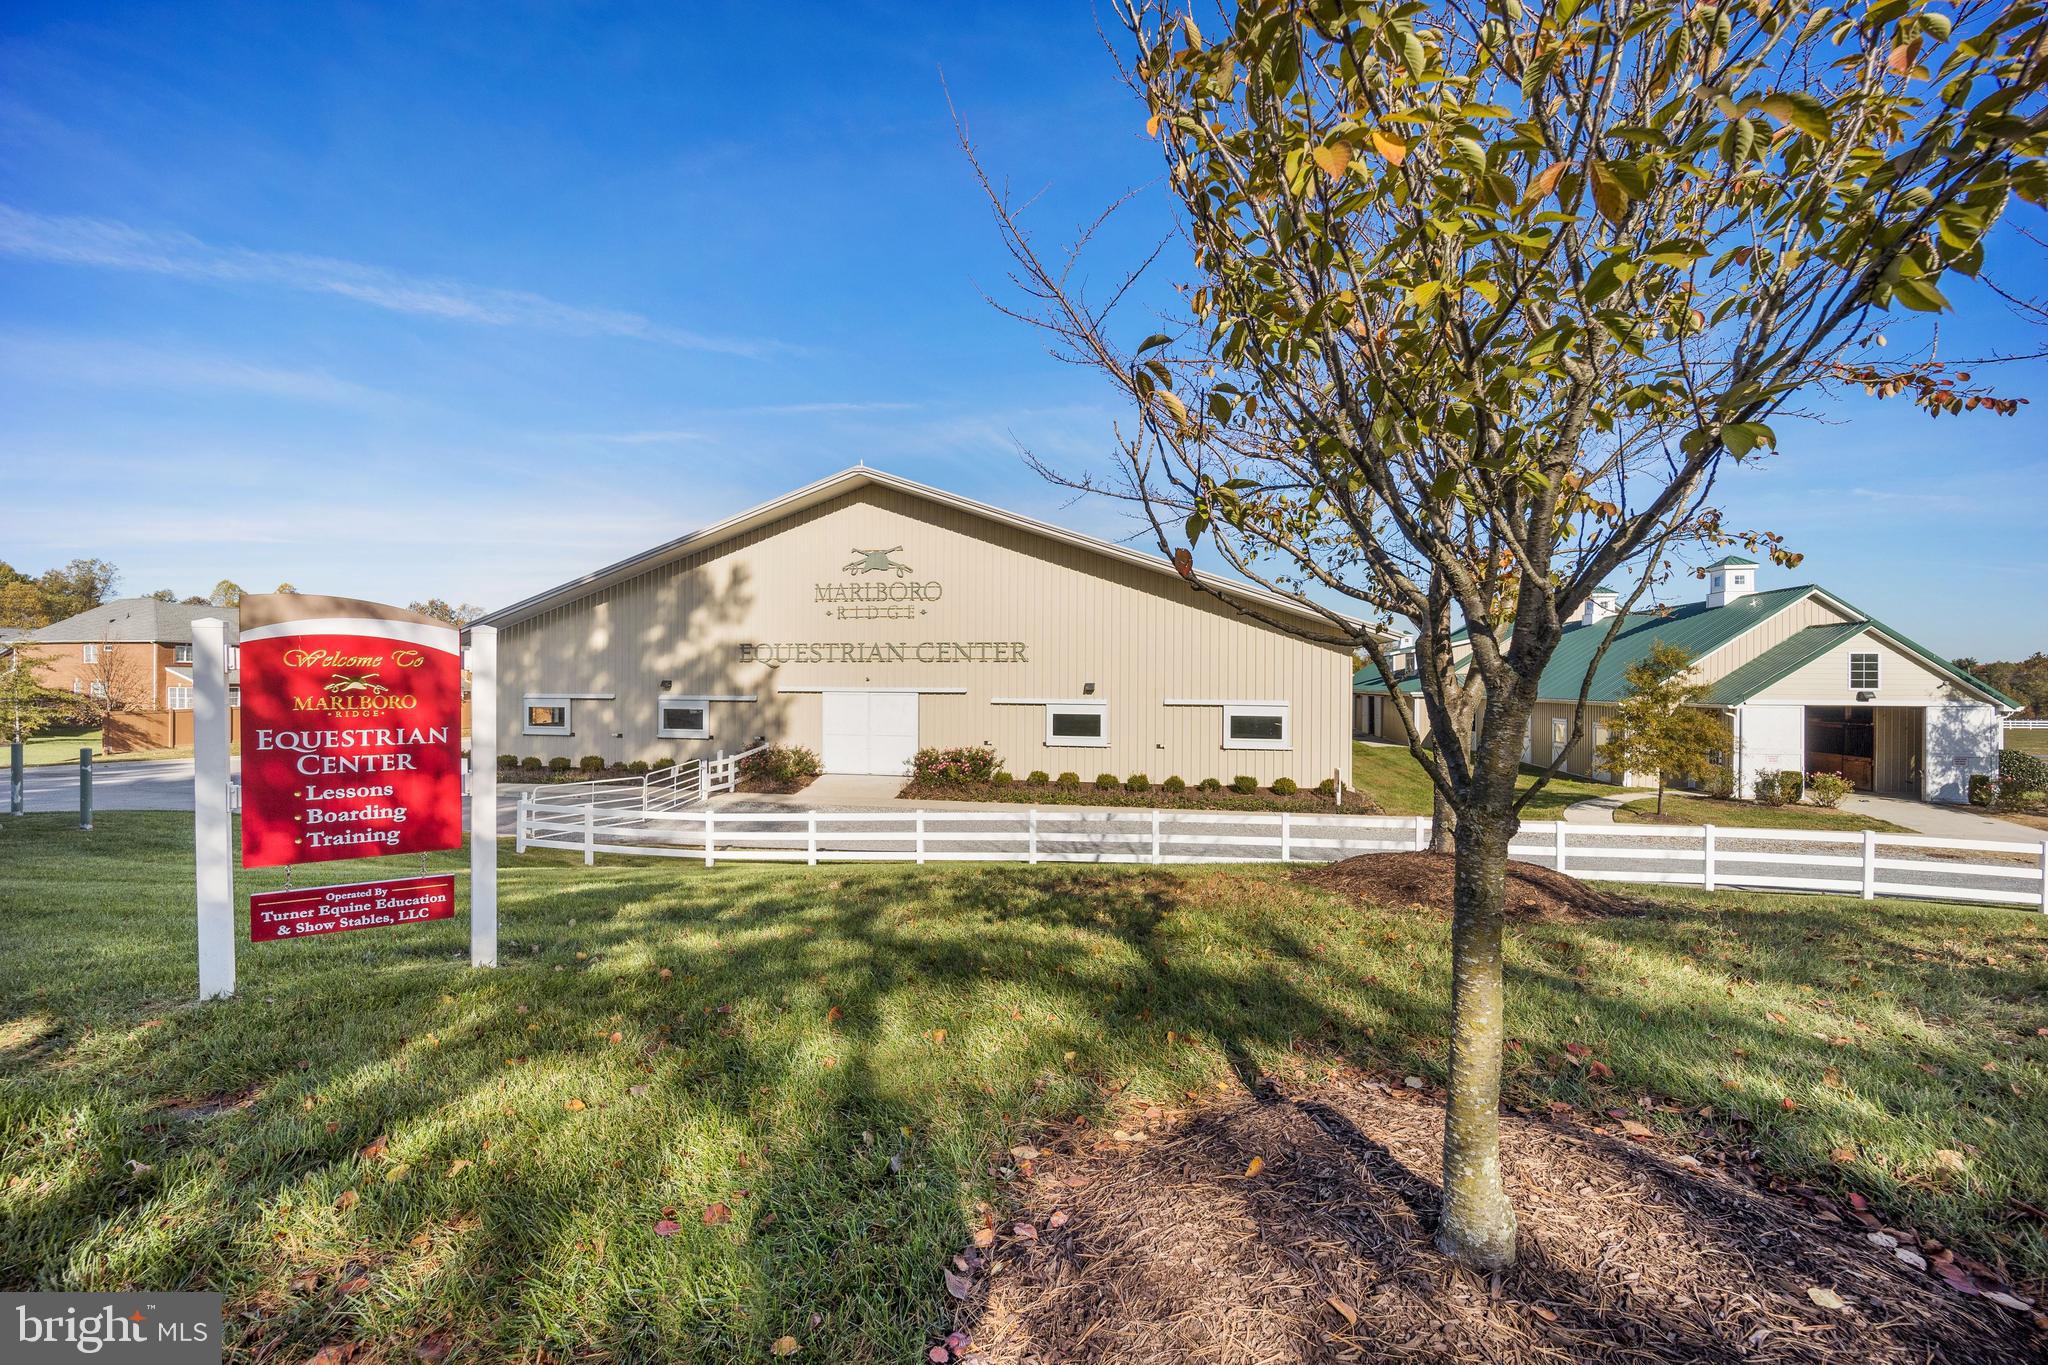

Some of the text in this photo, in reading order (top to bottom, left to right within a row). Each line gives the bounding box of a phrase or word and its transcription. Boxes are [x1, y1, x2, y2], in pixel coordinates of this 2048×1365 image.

[815, 581, 943, 603] MARLBORO
[836, 604, 915, 620] RIDGE
[283, 649, 425, 667] Welcome To
[739, 641, 1029, 669] EQUESTRIAN CENTER
[292, 695, 417, 711] MARLBORO
[335, 710, 379, 718] RIDGE
[256, 727, 449, 753] EQUESTRIAN
[297, 753, 417, 775] CENTER
[305, 784, 394, 801] Lessons
[306, 804, 407, 824] Boarding
[306, 828, 400, 847] Training
[325, 888, 388, 902] Operated By
[261, 893, 447, 923] Turner Equine Education
[276, 907, 430, 936] & Show Stables, LLC
